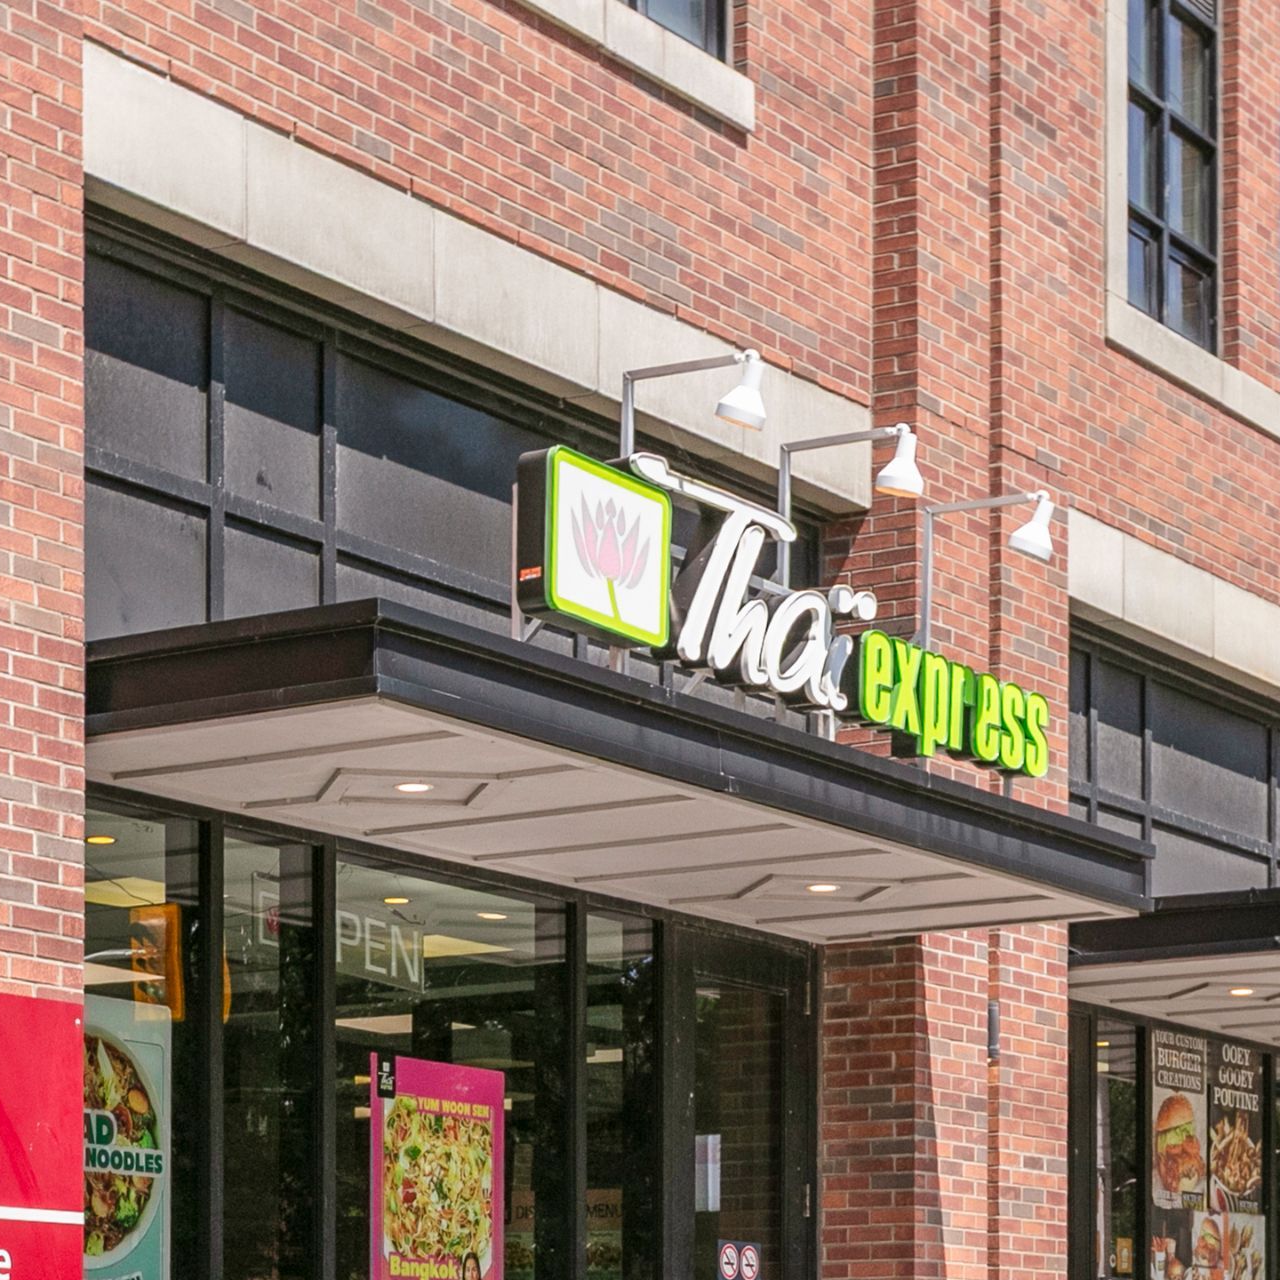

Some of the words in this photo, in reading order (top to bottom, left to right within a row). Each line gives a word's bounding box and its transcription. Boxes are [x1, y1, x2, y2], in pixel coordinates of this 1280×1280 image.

[859, 629, 1049, 779] express
[1155, 1030, 1175, 1046] YOUR
[1175, 1034, 1204, 1051] CUSTOM
[1157, 1047, 1202, 1073] BURGER
[1222, 1043, 1251, 1066] OOEY
[1158, 1069, 1201, 1091] CREATIONS
[1218, 1065, 1255, 1089] GOOEY
[417, 1097, 440, 1112] YUM
[441, 1099, 471, 1116] WOON
[1213, 1086, 1259, 1112] POUTINE
[84, 1146, 163, 1174] NOODLES
